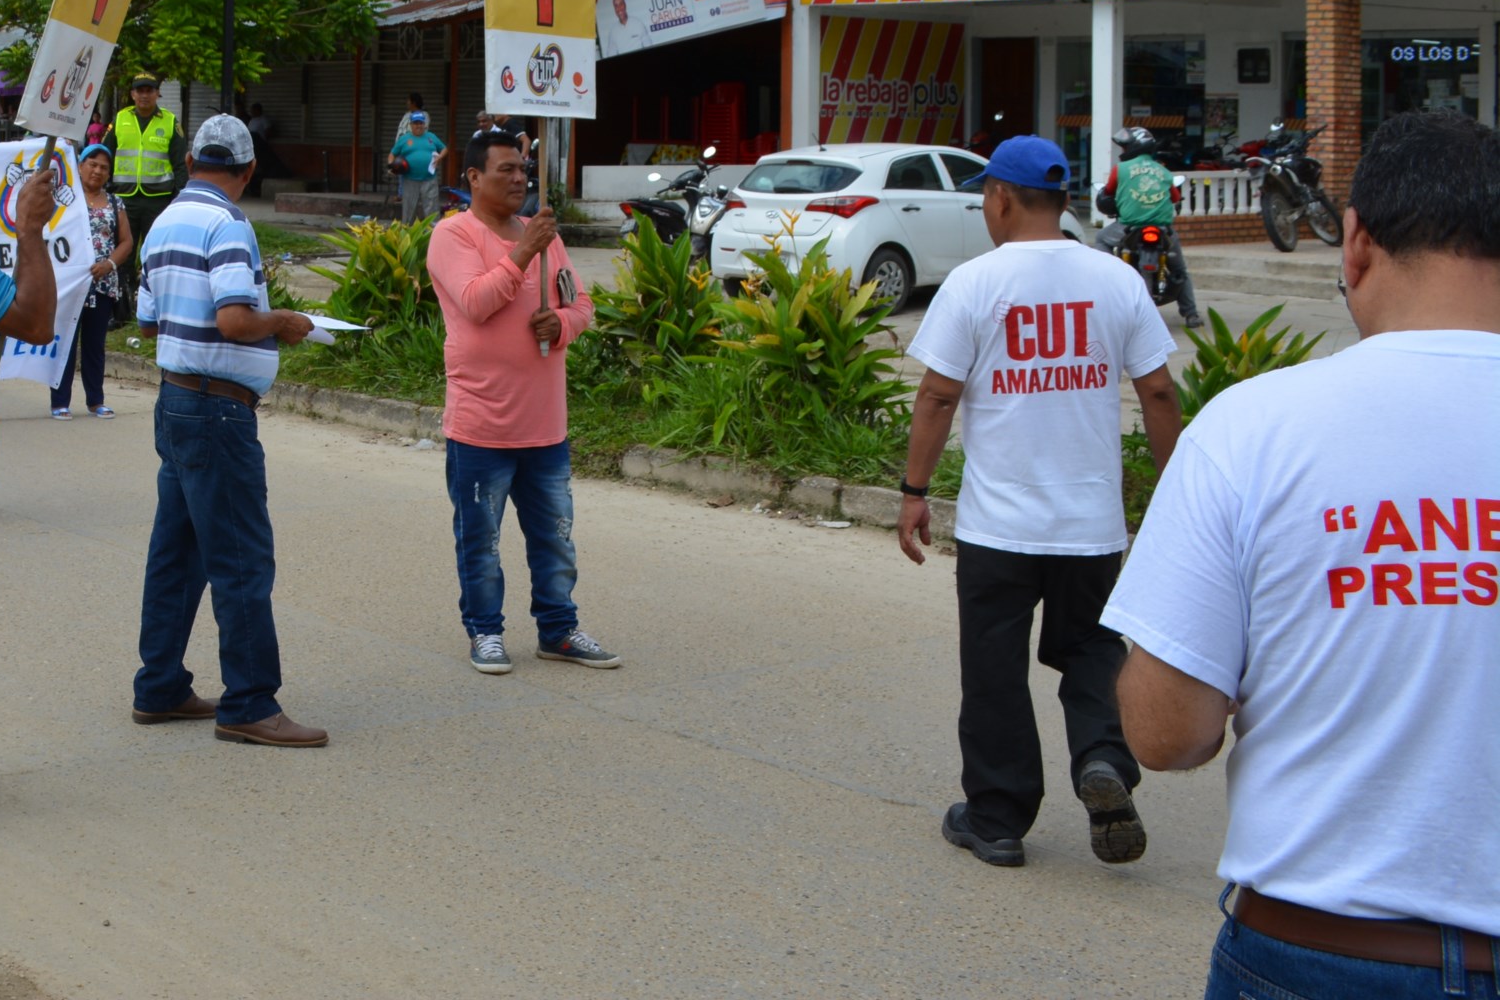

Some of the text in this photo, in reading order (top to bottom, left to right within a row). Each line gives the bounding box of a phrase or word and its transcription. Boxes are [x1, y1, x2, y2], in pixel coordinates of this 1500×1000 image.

[651, 6, 689, 25] CARLOS
[1391, 46, 1415, 61] OS
[1419, 46, 1453, 61] LOS
[822, 75, 959, 114] la rebaja plus
[1005, 301, 1094, 361] CUT
[992, 363, 1108, 394] AMAZONAS
[1327, 561, 1500, 609] PRES
